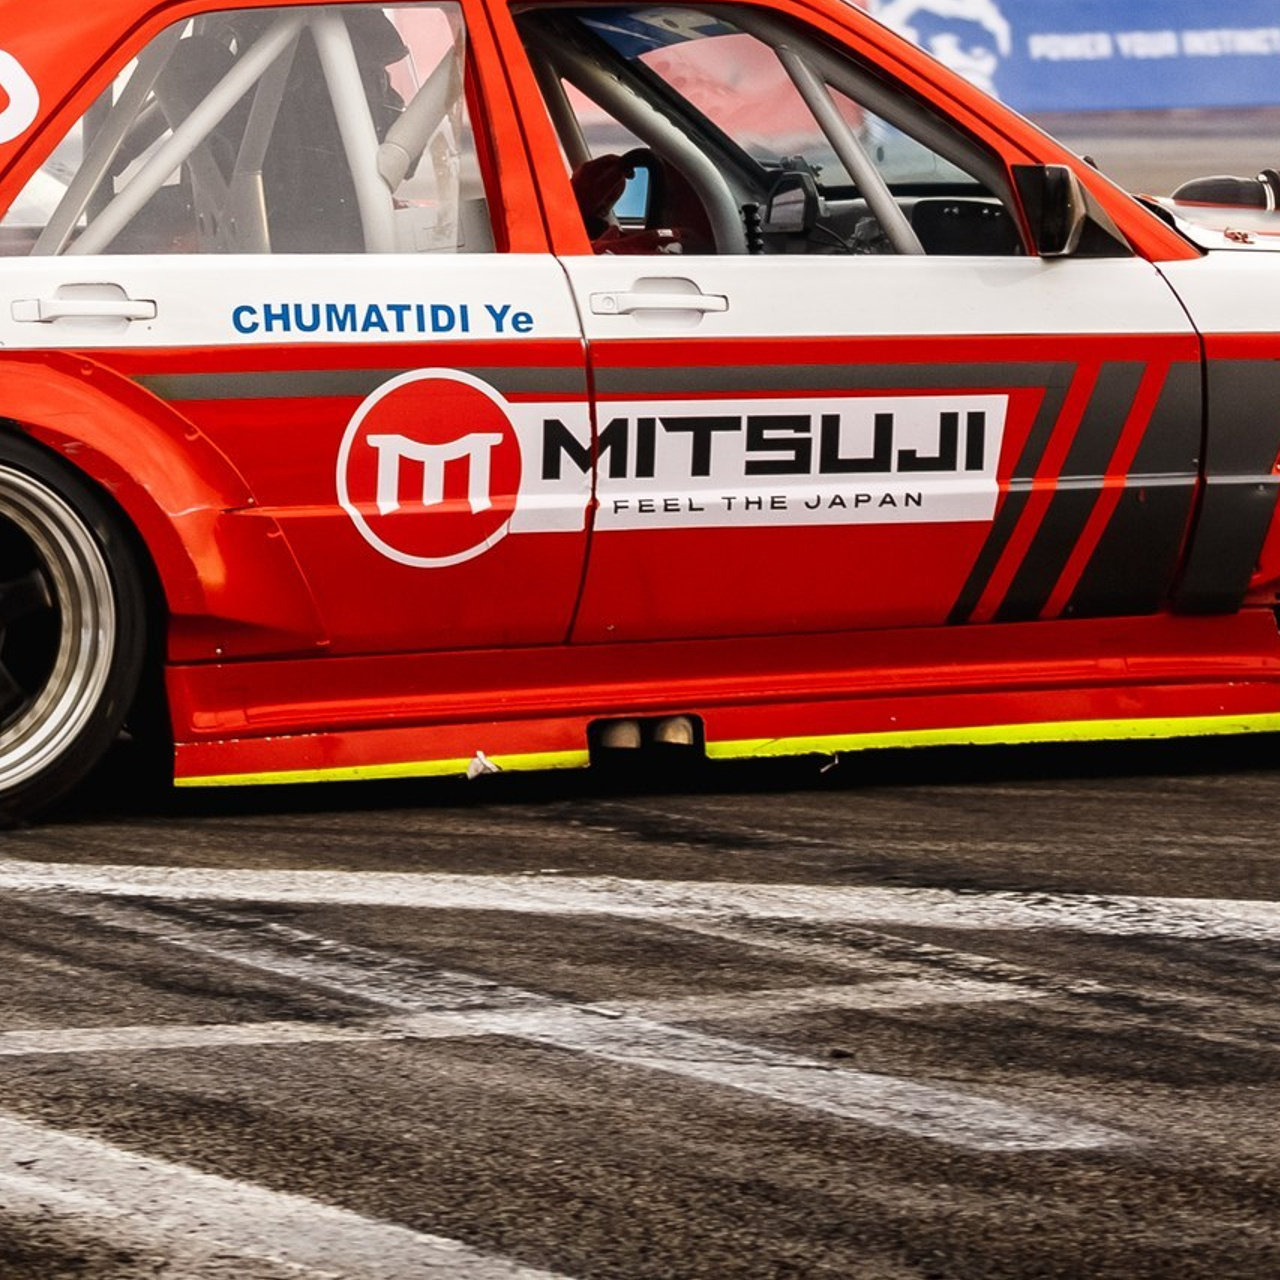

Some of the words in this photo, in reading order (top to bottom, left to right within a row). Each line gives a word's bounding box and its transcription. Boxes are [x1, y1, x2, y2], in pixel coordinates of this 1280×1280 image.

[1028, 32, 1112, 60] POWER
[1116, 30, 1178, 58] YOUR
[232, 302, 470, 334] CHUMATIDI
[484, 304, 534, 335] Ye
[541, 411, 986, 480] MITSUJI
[612, 497, 706, 515] FEEL
[722, 494, 790, 512] THE
[805, 492, 924, 510] JAPAN
